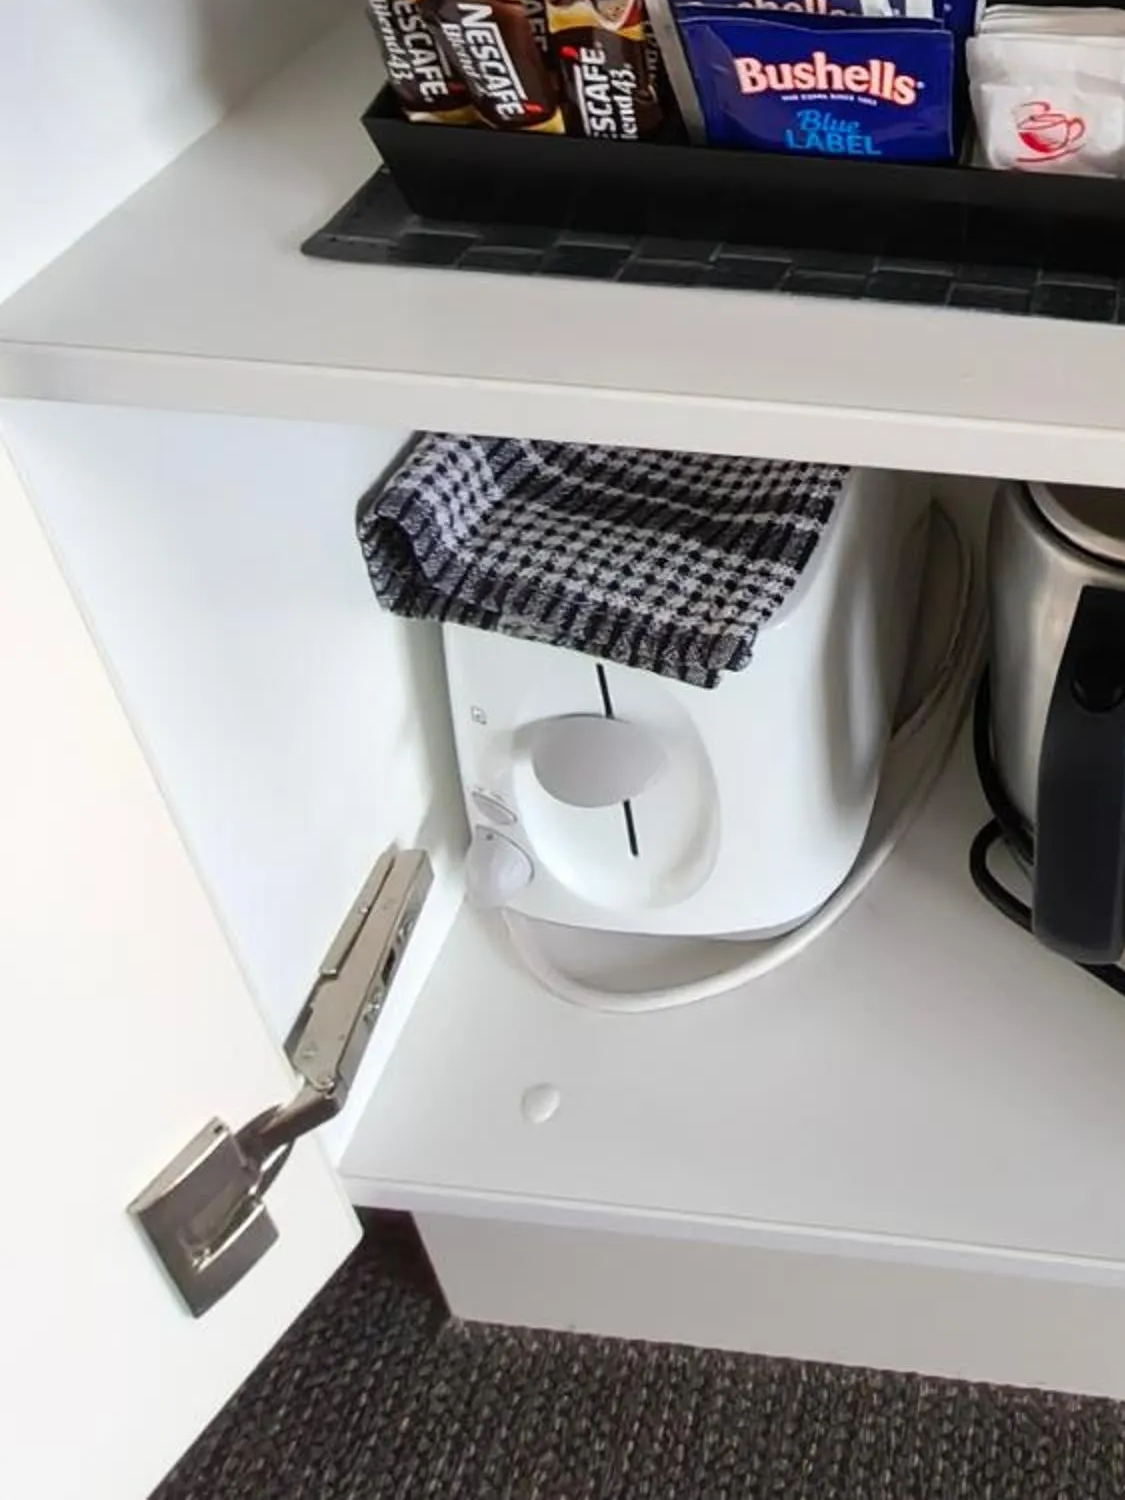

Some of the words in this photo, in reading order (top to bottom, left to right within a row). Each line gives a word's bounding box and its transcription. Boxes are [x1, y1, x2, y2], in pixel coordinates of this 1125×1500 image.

[735, 51, 920, 107] Bushells
[796, 109, 860, 133] Blue
[784, 129, 883, 155] LABEL
